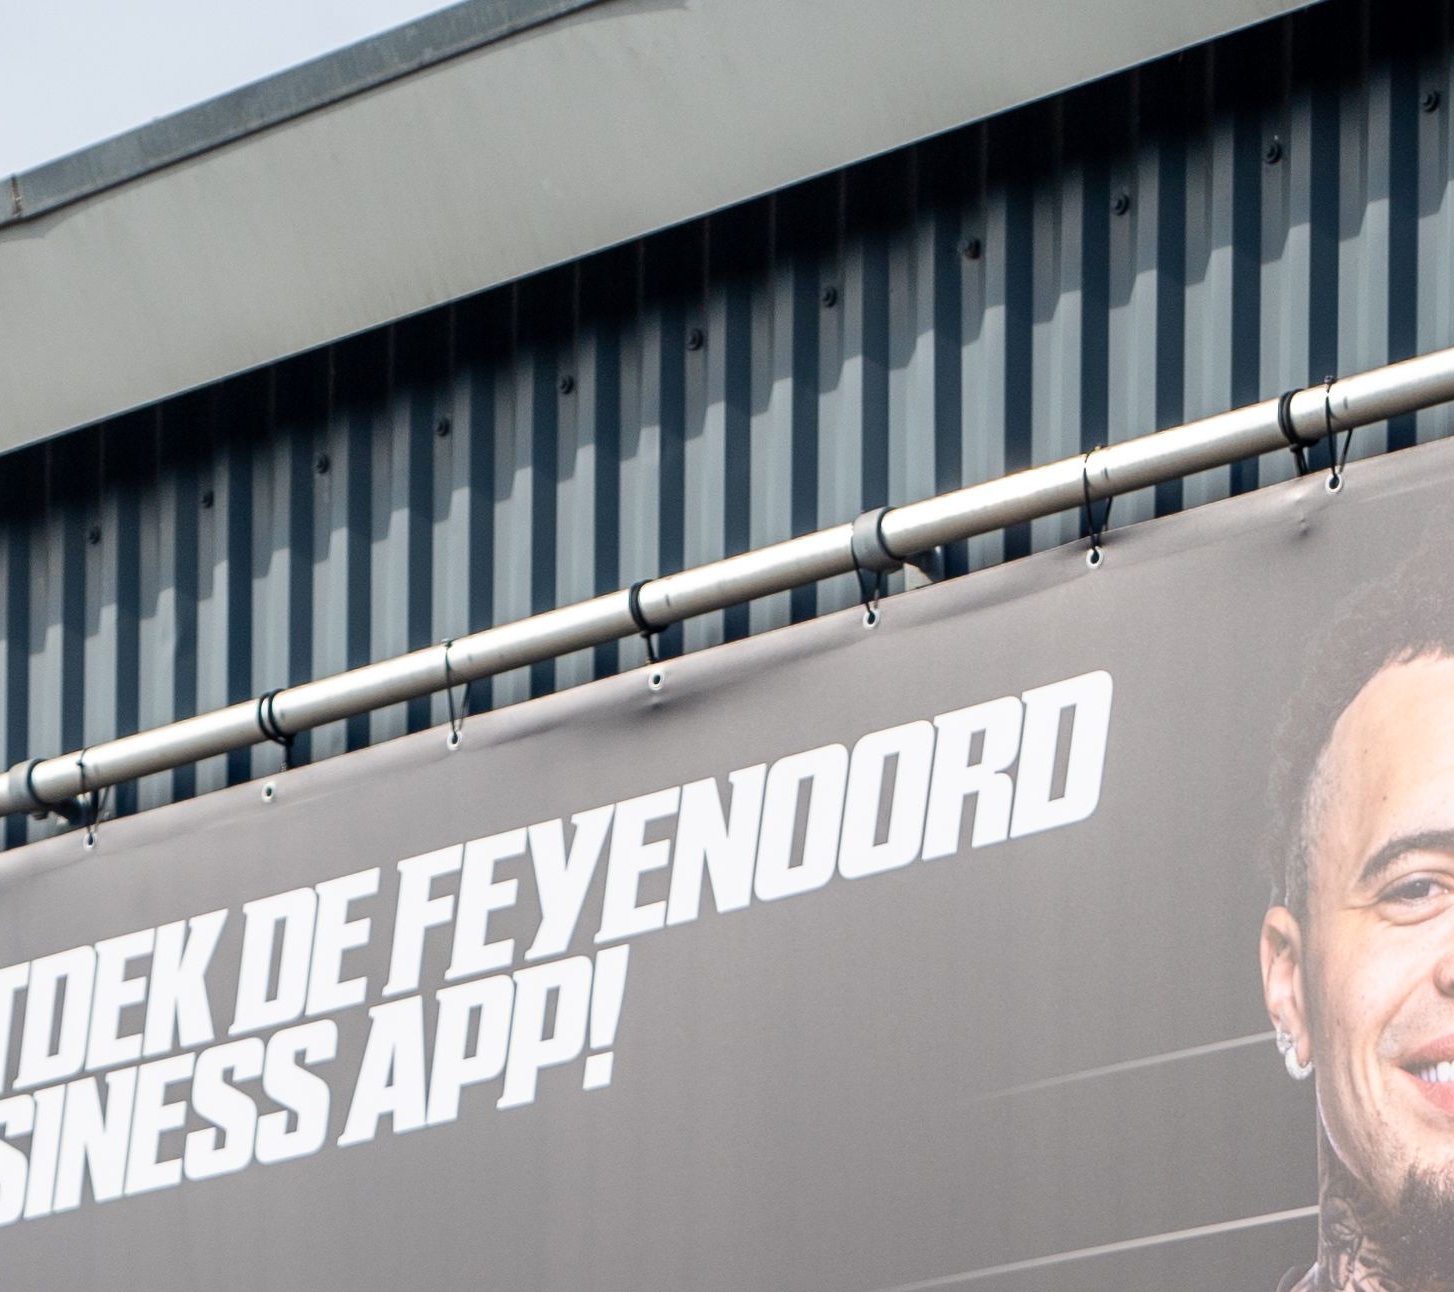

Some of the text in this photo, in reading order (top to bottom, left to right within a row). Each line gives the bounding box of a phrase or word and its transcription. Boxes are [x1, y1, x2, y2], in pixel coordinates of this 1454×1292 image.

[230, 866, 380, 1035] DE
[382, 669, 1113, 996] FEYENOORD
[338, 944, 628, 1148] APP!
